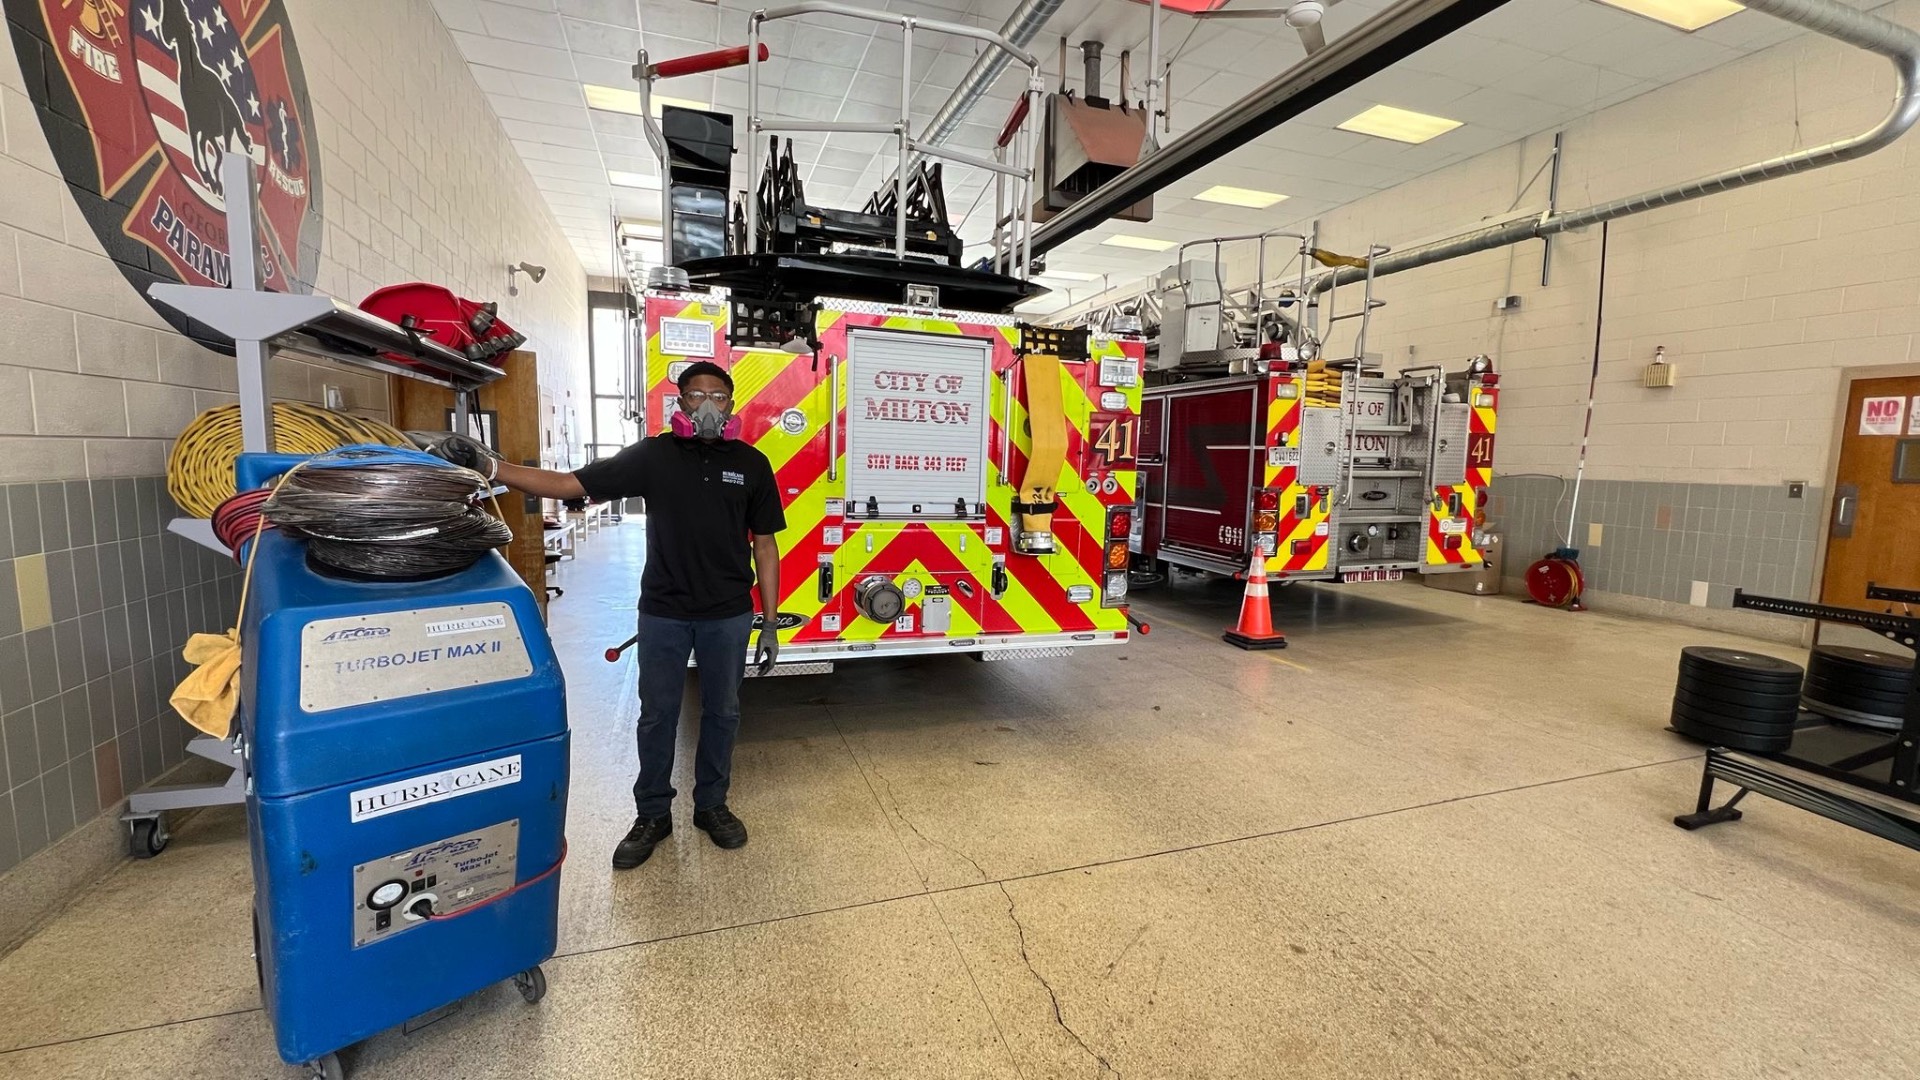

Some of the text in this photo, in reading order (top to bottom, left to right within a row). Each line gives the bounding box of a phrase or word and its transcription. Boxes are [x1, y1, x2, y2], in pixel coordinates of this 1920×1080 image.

[69, 26, 122, 83] FIRE
[269, 157, 306, 197] RESCUE
[874, 370, 963, 394] CITY OF
[864, 396, 971, 425] MILTON
[1347, 401, 1384, 416] TY OF
[1867, 400, 1899, 417] NO
[1094, 418, 1135, 463] 41
[1471, 437, 1491, 463] 41
[867, 453, 891, 470] STAY
[895, 454, 919, 471] BACK
[946, 456, 967, 472] FEET
[335, 641, 501, 674] TURBOJET MAX II
[357, 762, 520, 813] HURRICANE
[453, 851, 499, 869] TurboJet
[460, 861, 481, 873] Max
